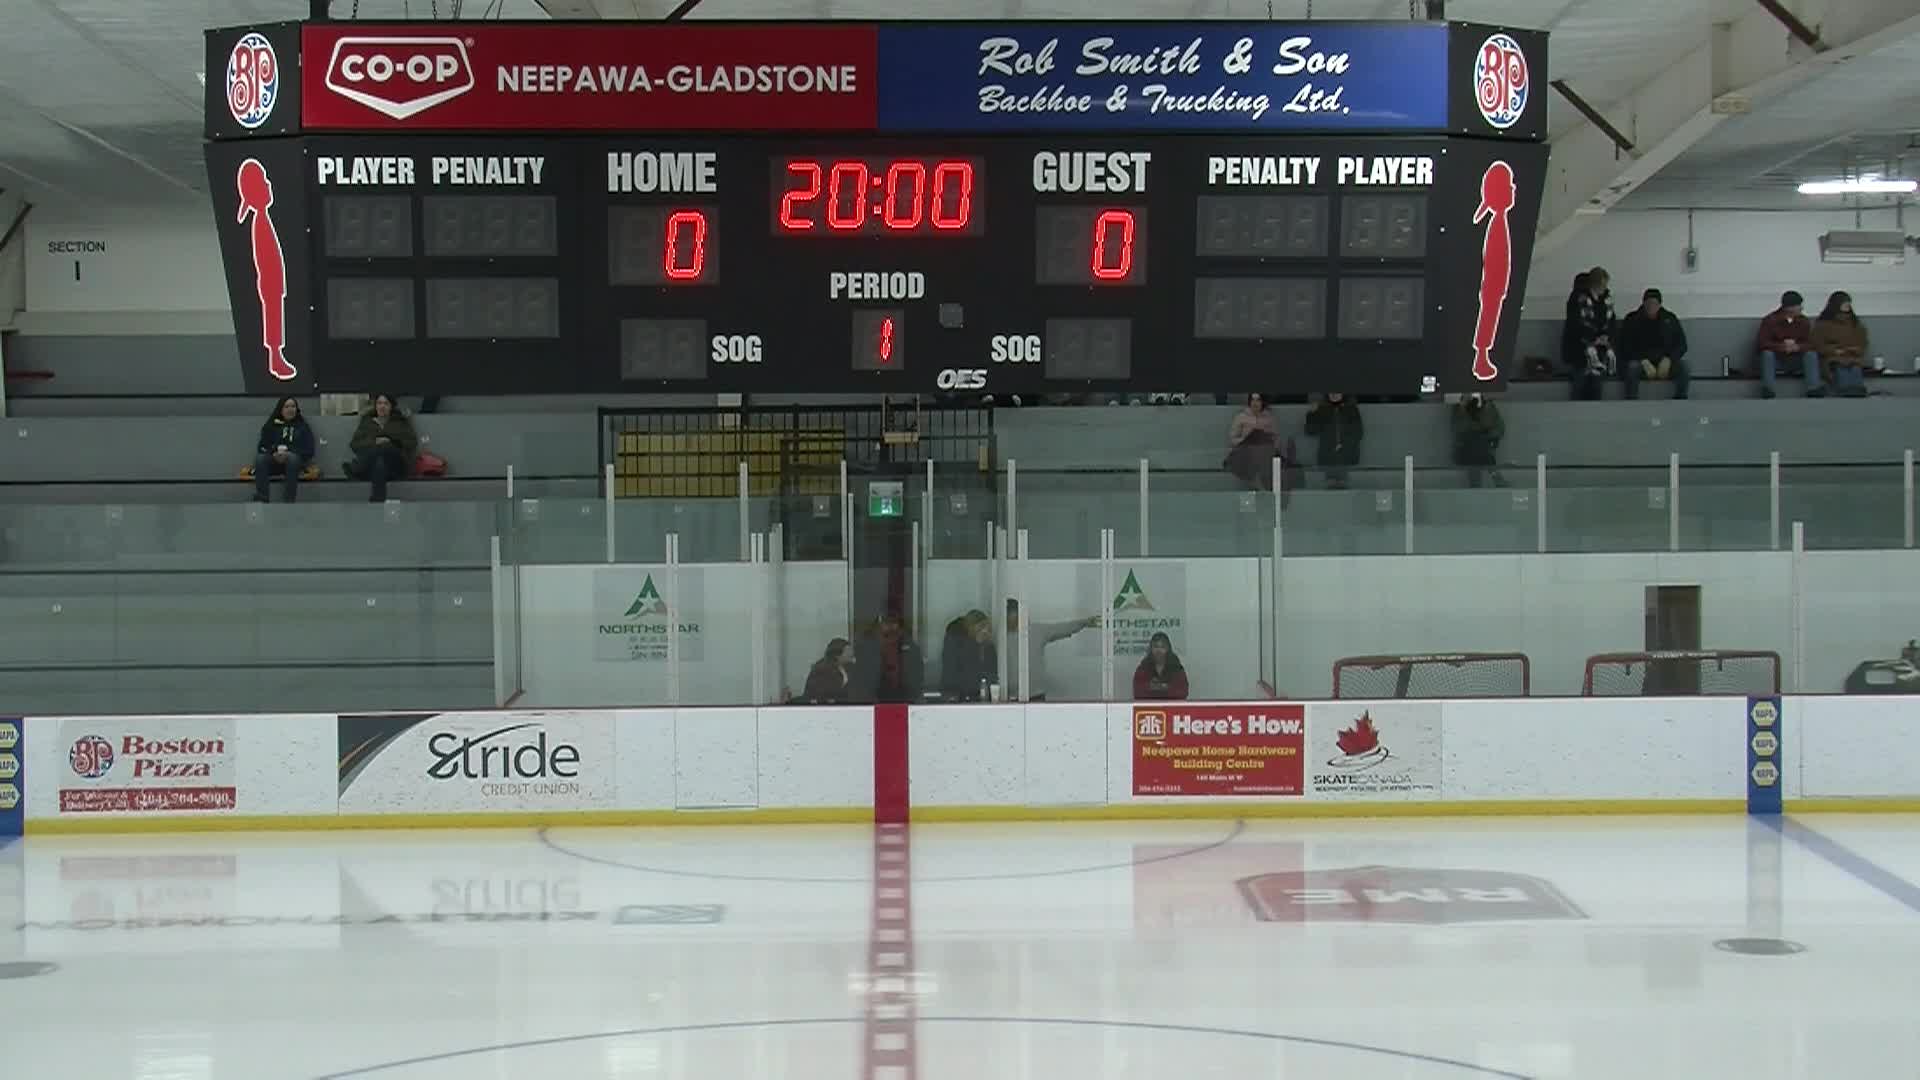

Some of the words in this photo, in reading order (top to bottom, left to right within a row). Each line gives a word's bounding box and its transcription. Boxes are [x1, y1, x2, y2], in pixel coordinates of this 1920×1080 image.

[341, 54, 459, 82] CO-OP
[978, 37, 1058, 76] Rob
[1075, 37, 1202, 75] Smith
[1222, 37, 1254, 75] &
[1273, 37, 1350, 75] Son
[497, 65, 857, 92] NEEPAWA-GLADSTONE
[978, 84, 1092, 113] Backhoe
[1105, 84, 1128, 113] &
[1142, 84, 1271, 120] Trucking
[1282, 83, 1351, 114] Ltd.
[317, 157, 416, 185] PLAYER
[431, 157, 545, 185] PENALTY
[607, 152, 717, 193] HOME
[1033, 151, 1152, 193] GUEST
[1208, 157, 1321, 185] PENALTY
[1337, 157, 1434, 185] PLAYER
[780, 161, 973, 230] 20:00
[48, 241, 105, 253] SECTION
[664, 211, 706, 280] 0
[1091, 209, 1135, 280] 0
[830, 272, 925, 300] PERIOD
[712, 335, 763, 363] SOG
[879, 317, 893, 361] 1
[991, 335, 1041, 363] SOG
[937, 368, 987, 390] OES
[1172, 714, 1242, 735] Here's
[1248, 714, 1304, 735] How.
[121, 735, 225, 755] Boston
[427, 723, 580, 779] Stride
[1142, 747, 1200, 757] Neepawa
[1203, 746, 1235, 756] Home
[1238, 745, 1296, 755] Hardware
[133, 758, 211, 777] Pizza
[1173, 759, 1223, 770] Building
[1226, 759, 1265, 769] Centre
[481, 784, 530, 796] CREDIT
[534, 783, 580, 795] UNION
